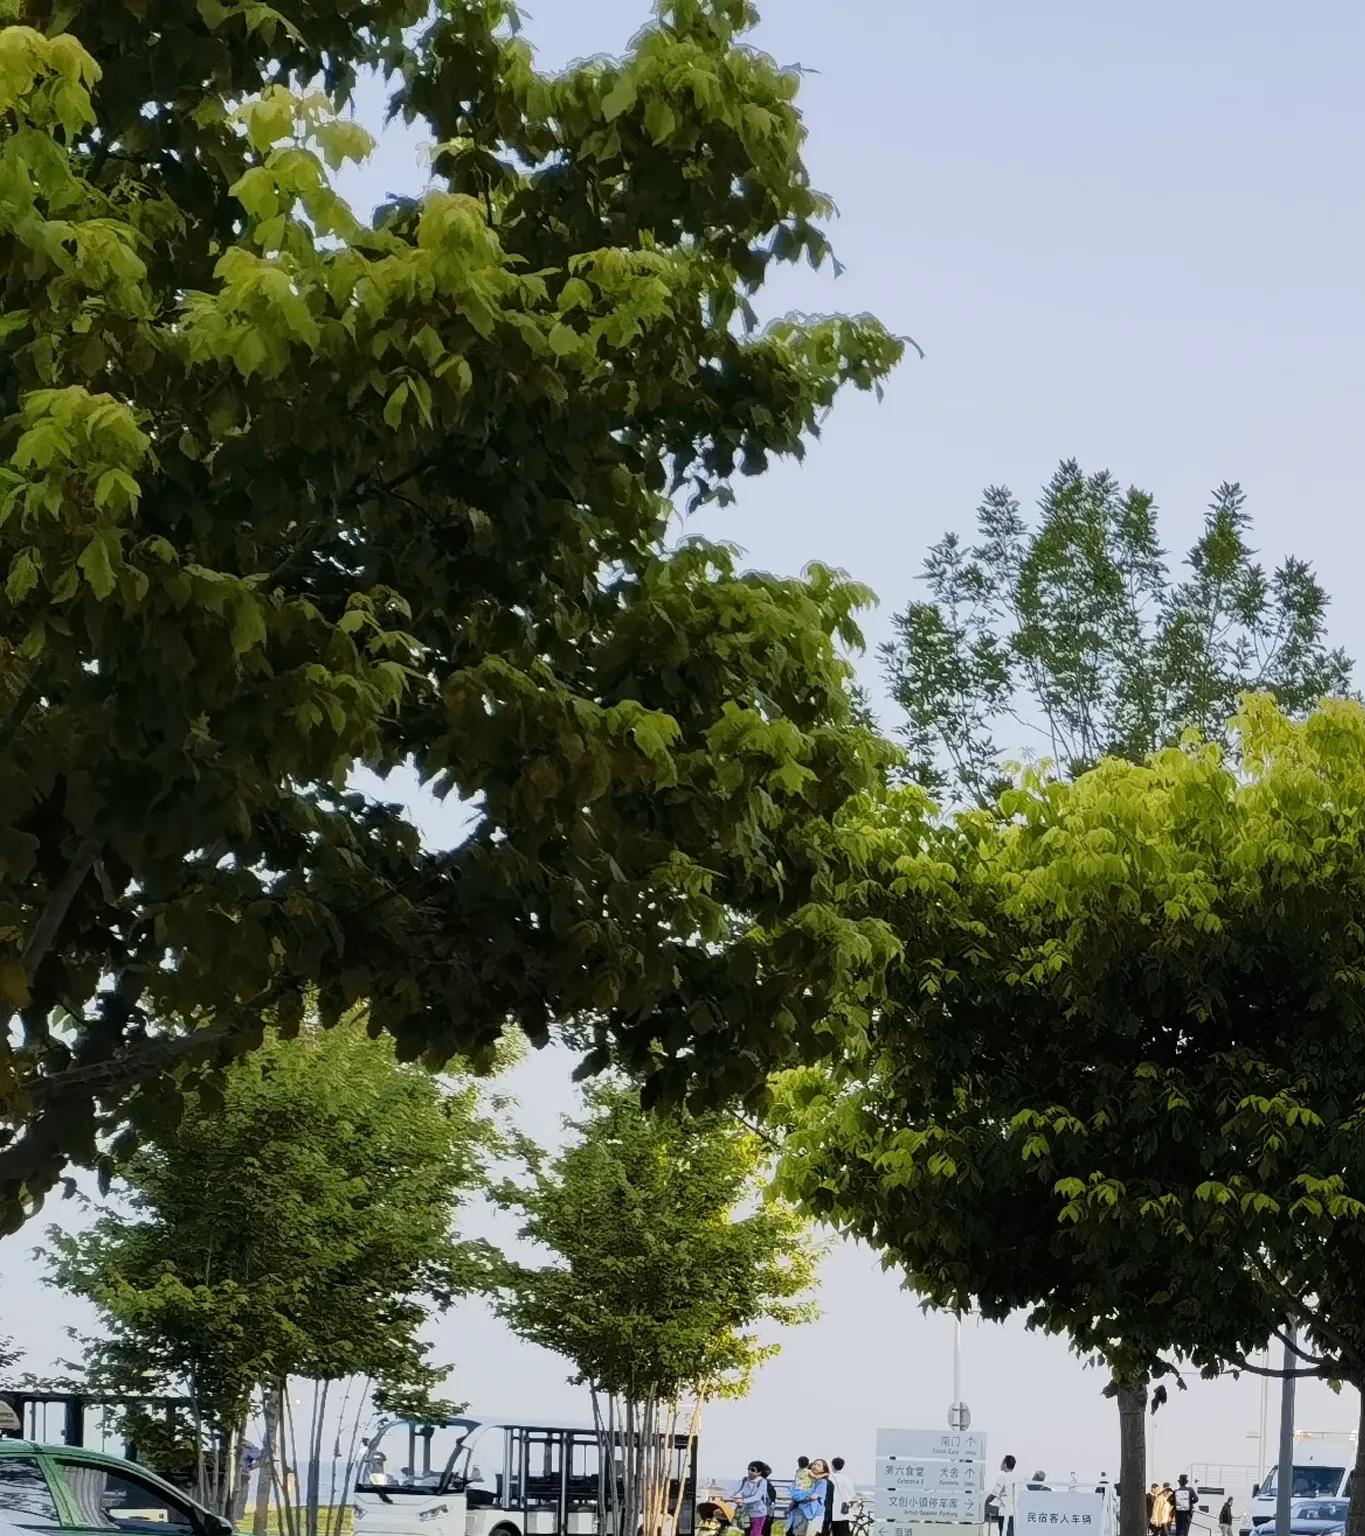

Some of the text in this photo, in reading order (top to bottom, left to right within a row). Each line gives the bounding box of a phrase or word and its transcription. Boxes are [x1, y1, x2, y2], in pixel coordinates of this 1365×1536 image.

[1026, 1512, 1093, 1526] 民宿客人车辆
